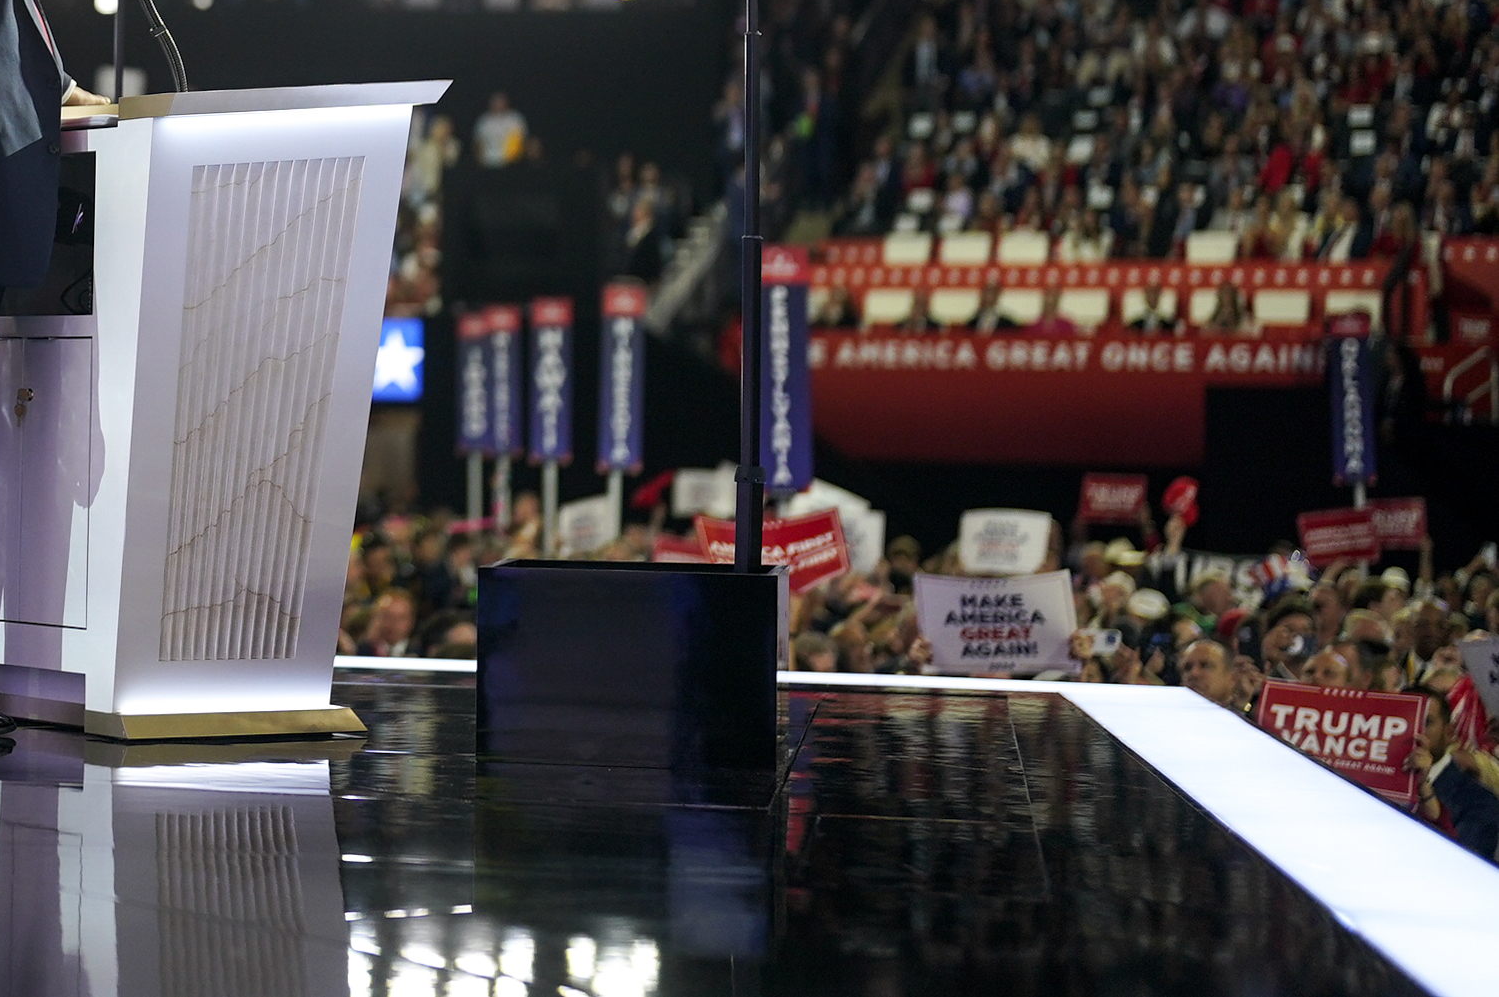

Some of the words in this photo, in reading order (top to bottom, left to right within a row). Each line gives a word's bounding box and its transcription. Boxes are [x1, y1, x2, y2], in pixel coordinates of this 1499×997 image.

[835, 339, 976, 370] AMERICA
[985, 340, 1093, 371] GREAT
[1101, 342, 1195, 372] ONCE
[1340, 338, 1365, 474] OKLAHOMA
[959, 592, 1023, 608] MAKE
[944, 609, 1046, 626] AMERICA
[960, 625, 1032, 641] GREAT
[961, 640, 1039, 657] AGAIN!
[1270, 703, 1408, 740] TRUMP
[1281, 728, 1389, 763] VANCE
[1333, 759, 1363, 771] GREAT
